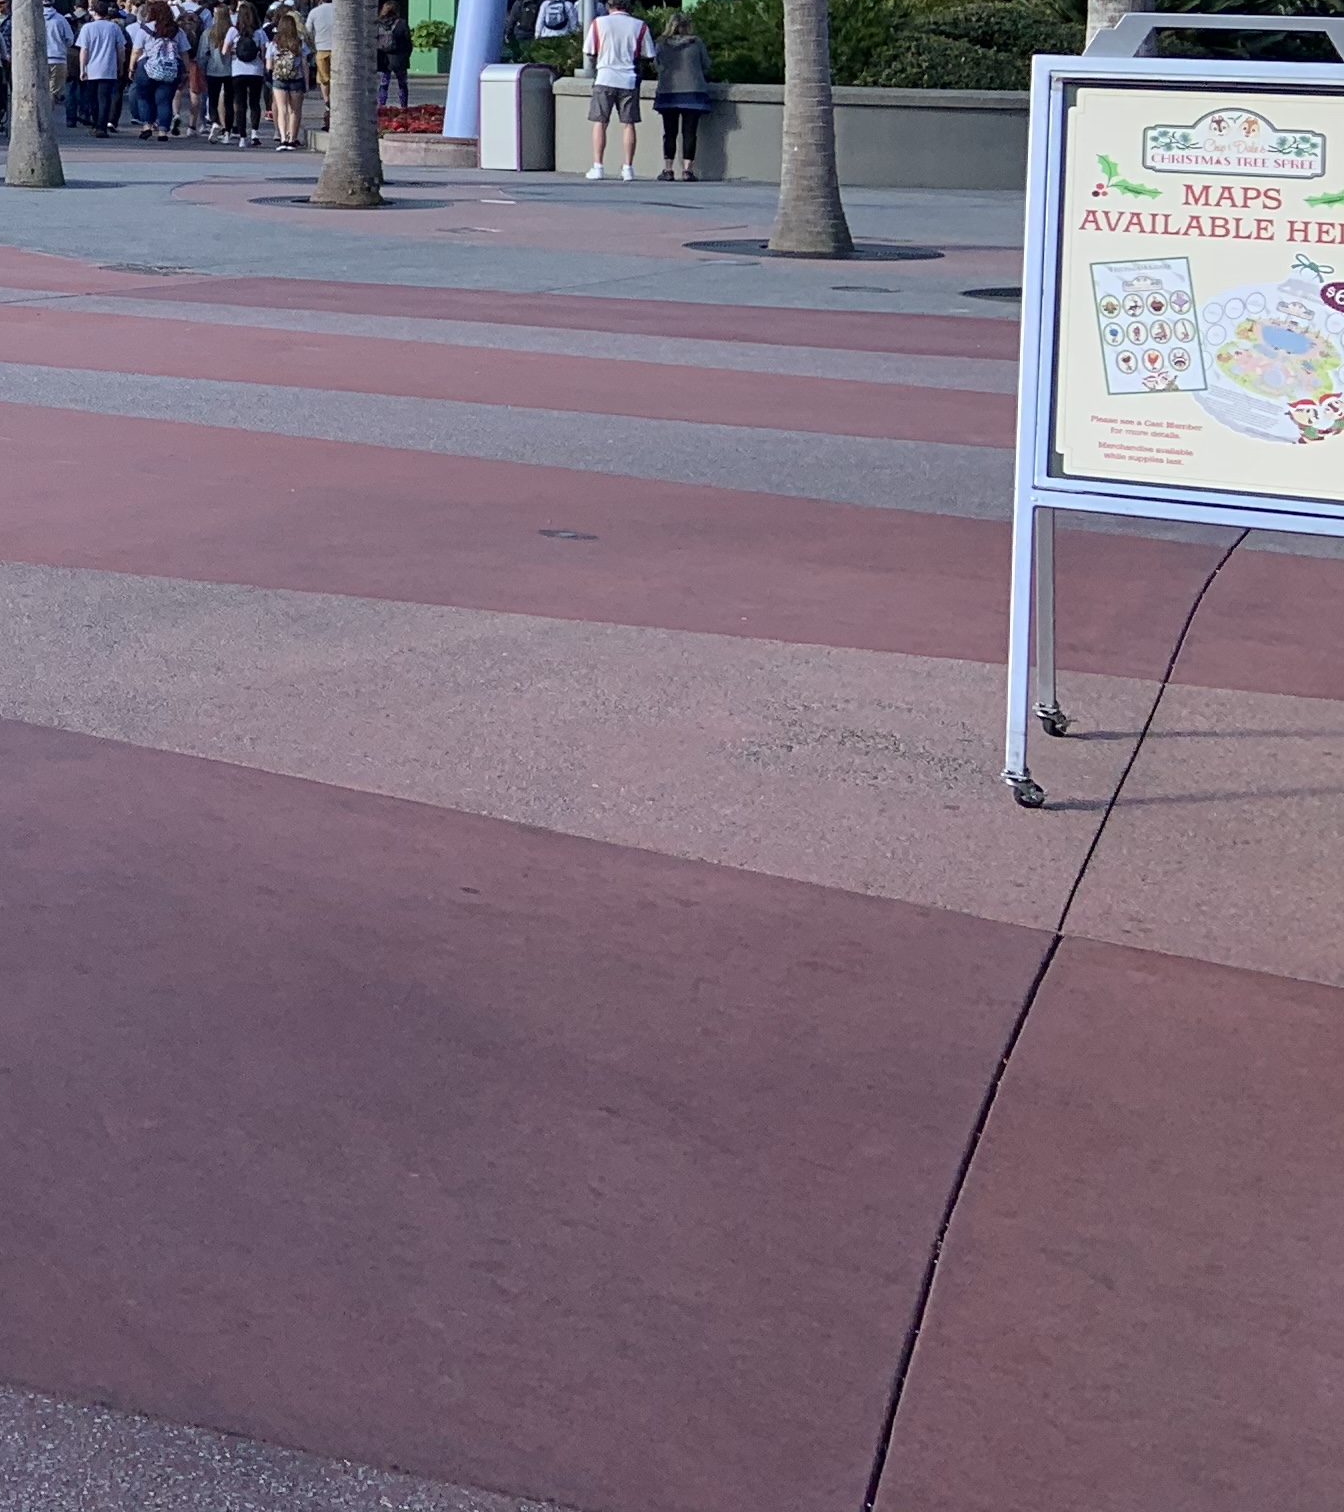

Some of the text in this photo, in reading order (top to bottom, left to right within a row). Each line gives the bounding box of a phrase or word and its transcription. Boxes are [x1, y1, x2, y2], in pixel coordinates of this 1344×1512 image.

[1151, 152, 1316, 170] CHRISTMAS TREE SPREE
[1182, 184, 1282, 210] MAPS
[1078, 209, 1275, 241] AVAILABLE
[1090, 415, 1118, 424] Please
[1144, 420, 1164, 428] Cast
[1166, 421, 1203, 431] Member
[1098, 441, 1194, 456] Merchandise available
[1103, 452, 1126, 461] while
[1128, 455, 1164, 464] supplies
